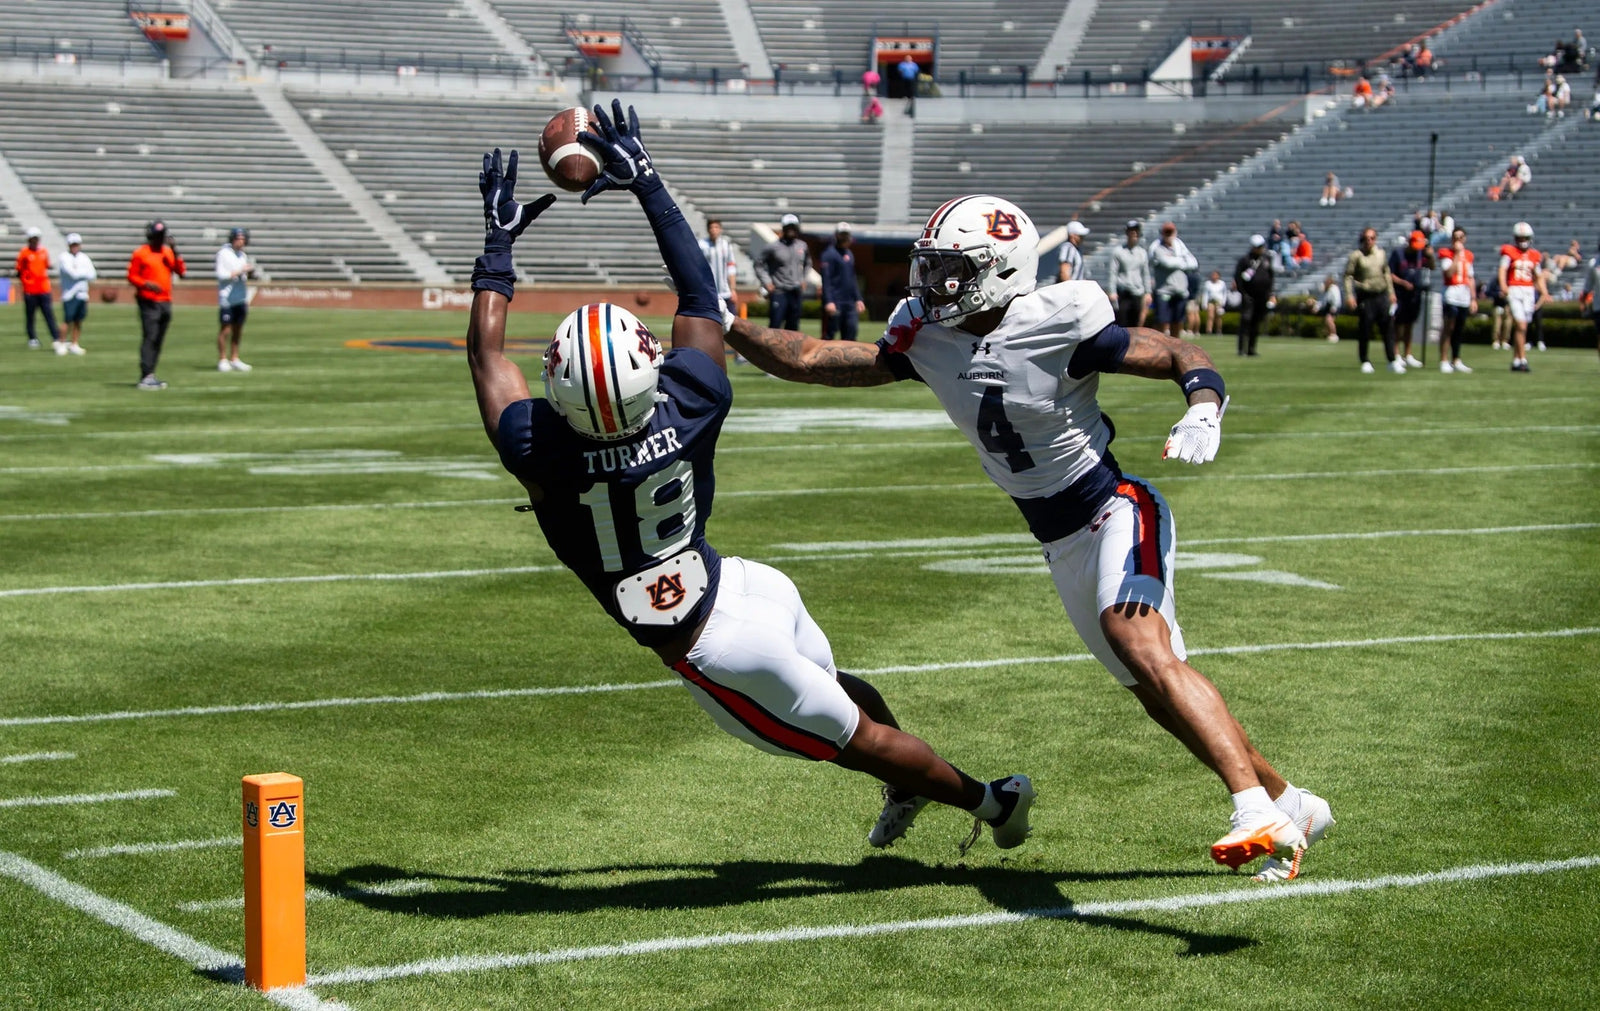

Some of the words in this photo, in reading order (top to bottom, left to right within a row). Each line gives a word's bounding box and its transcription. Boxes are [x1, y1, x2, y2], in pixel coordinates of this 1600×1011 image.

[957, 371, 1004, 380] AUBURN
[583, 427, 683, 474] TURNER
[977, 386, 1036, 473] 4
[579, 460, 697, 572] 18
